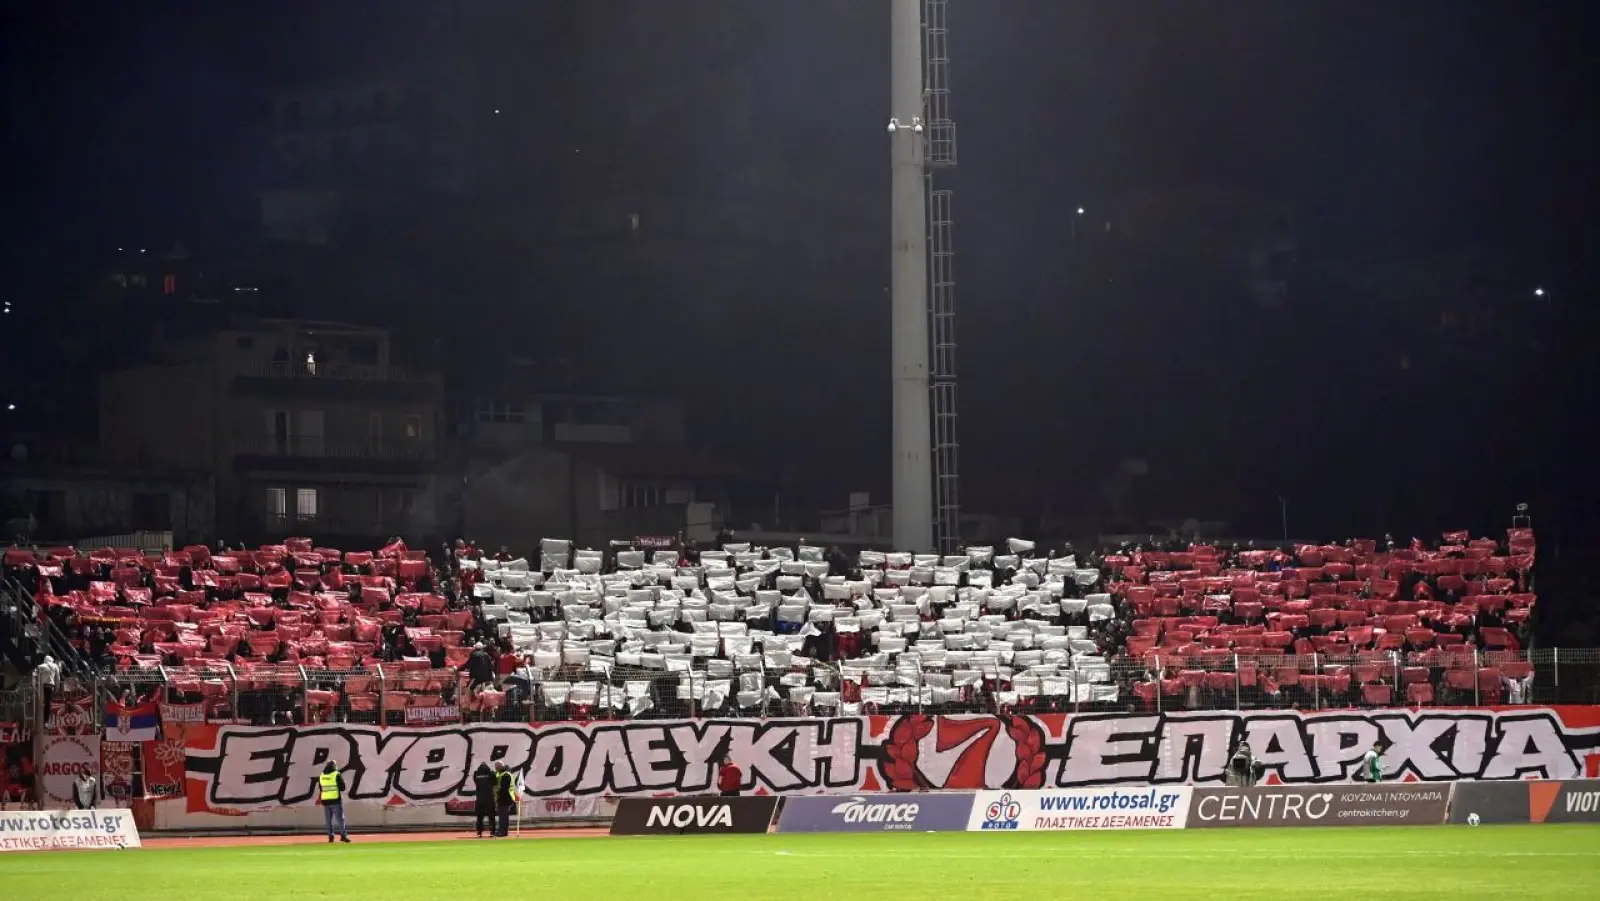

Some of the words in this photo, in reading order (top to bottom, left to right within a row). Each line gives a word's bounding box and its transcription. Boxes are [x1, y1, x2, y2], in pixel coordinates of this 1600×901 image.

[1055, 712, 1583, 788] ΕΠΑΡΧΙΑ
[43, 761, 90, 776] ARGOS
[210, 717, 863, 805] ΕΡΥΘΡΟΛΕΥΚΗ
[1040, 789, 1180, 813] www.rotosal.gr
[1198, 793, 1332, 820] CENTRO
[1341, 792, 1382, 802] ΚΟΥΖΙΝΑ
[1389, 791, 1442, 802] ΝΤΟΥΛΑΠΑ
[1566, 791, 1600, 812] VIOT
[646, 804, 733, 828] NOVA
[843, 802, 920, 823] avance
[1034, 816, 1100, 829] ΠΛΑΣΤΙΚΕΣ
[1100, 815, 1174, 828] ΔΕΞΑΜΕΝΕΣ
[1338, 807, 1410, 818] centrokitchen.gr
